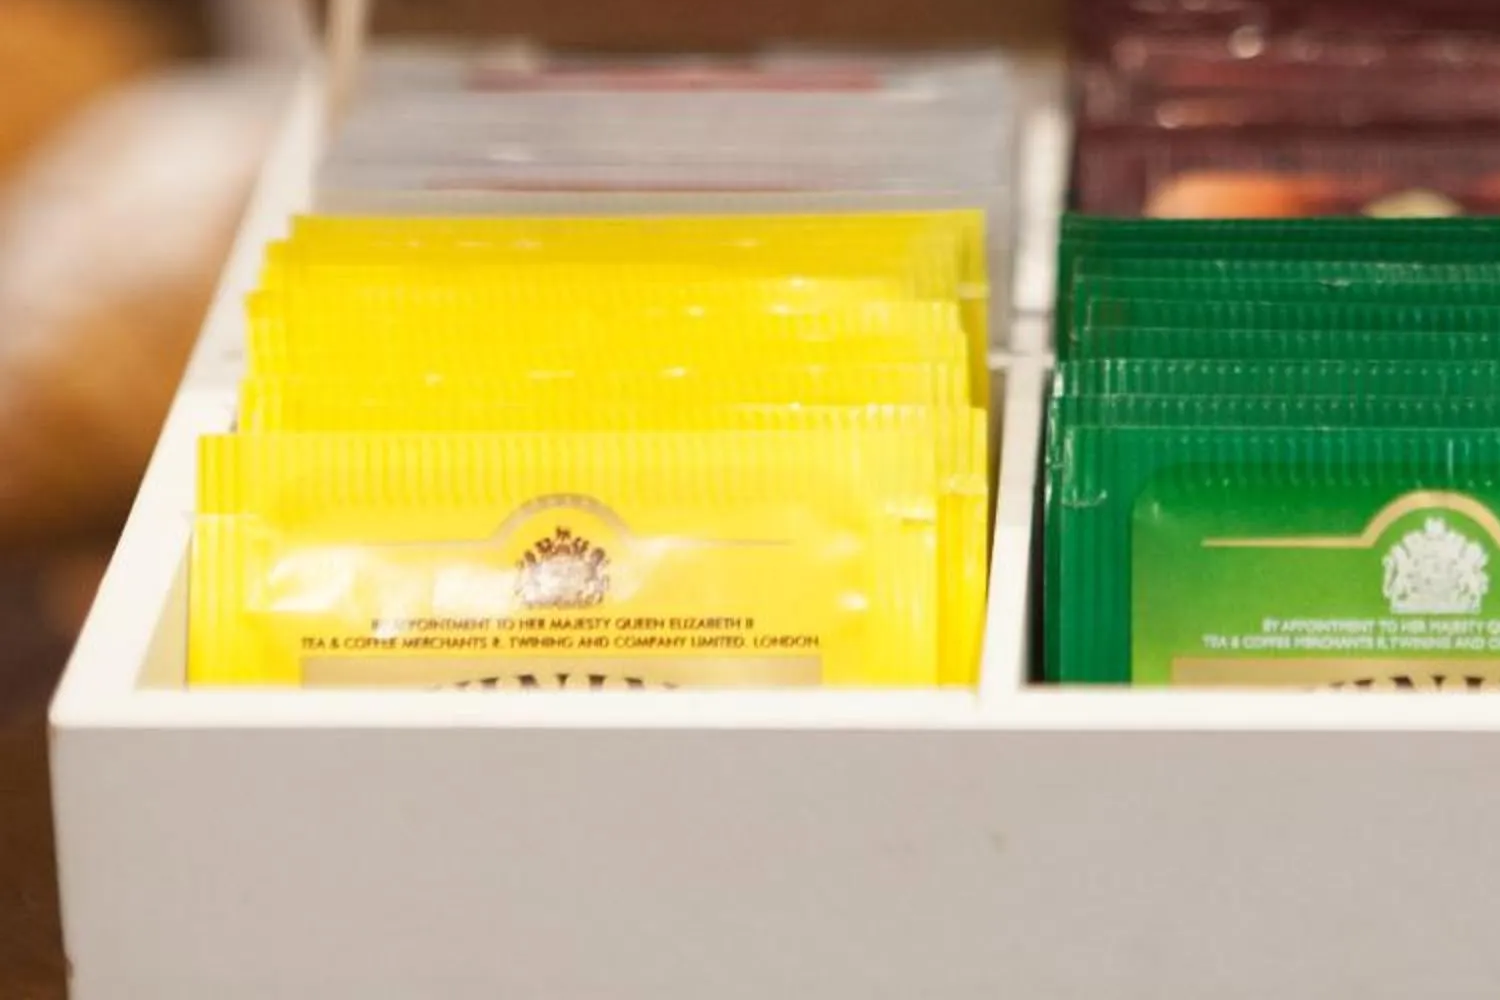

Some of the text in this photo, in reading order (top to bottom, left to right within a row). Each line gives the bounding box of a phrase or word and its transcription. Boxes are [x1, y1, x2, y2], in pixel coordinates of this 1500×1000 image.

[496, 617, 516, 631] TO
[519, 617, 545, 631] HER
[549, 617, 611, 631] MAJESTY
[615, 617, 665, 631] QUEEN
[669, 617, 740, 631] ELIZABETH
[1379, 618, 1398, 633] TO
[301, 636, 325, 649] TEA
[329, 636, 339, 649] &
[343, 636, 397, 649] COFFEE
[402, 636, 487, 649] MERCHANTS
[509, 636, 573, 649] TWINING
[577, 636, 609, 649] AND
[613, 636, 687, 649] COMPANY
[1455, 635, 1485, 650] AND
